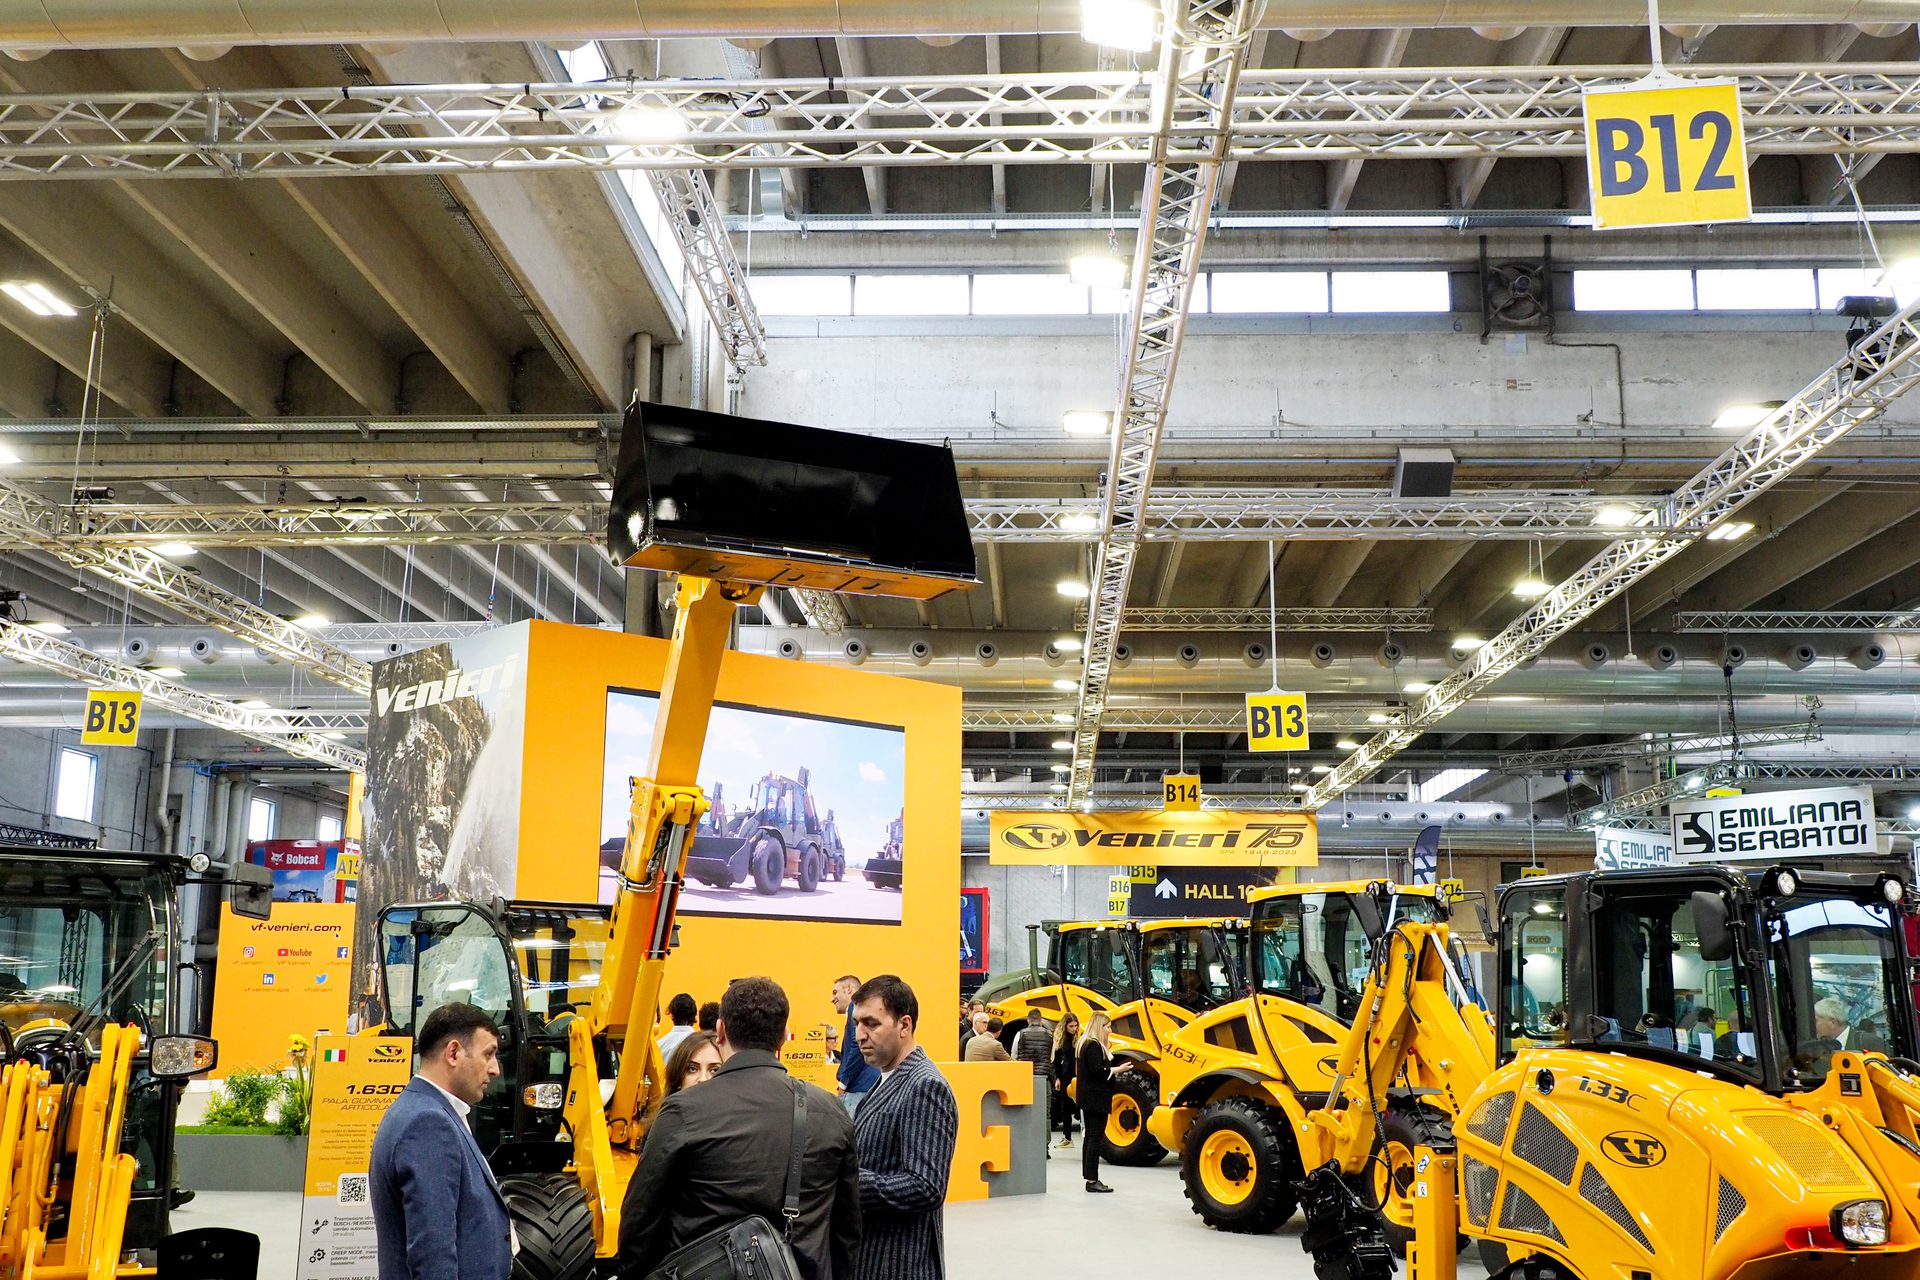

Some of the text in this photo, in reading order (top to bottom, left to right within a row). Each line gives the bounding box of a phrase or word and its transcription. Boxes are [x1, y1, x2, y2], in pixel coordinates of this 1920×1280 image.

[1595, 110, 1736, 197] B12
[86, 700, 137, 734] B13
[1250, 704, 1305, 739] B13
[1166, 784, 1198, 802] B14
[1719, 800, 1862, 830] EMILIANA
[1245, 823, 1308, 848] 75
[1718, 823, 1868, 853] SERBATOI
[286, 854, 319, 865] Bobcat
[1131, 866, 1156, 878] B15
[1110, 880, 1130, 893] B16
[1185, 884, 1235, 900] HALL
[1108, 900, 1125, 911] B17
[251, 922, 342, 932] vf-venieri.com
[289, 948, 313, 957] YouTube
[1161, 1042, 1207, 1068] 4.63H
[1578, 1075, 1648, 1112] 1.33C
